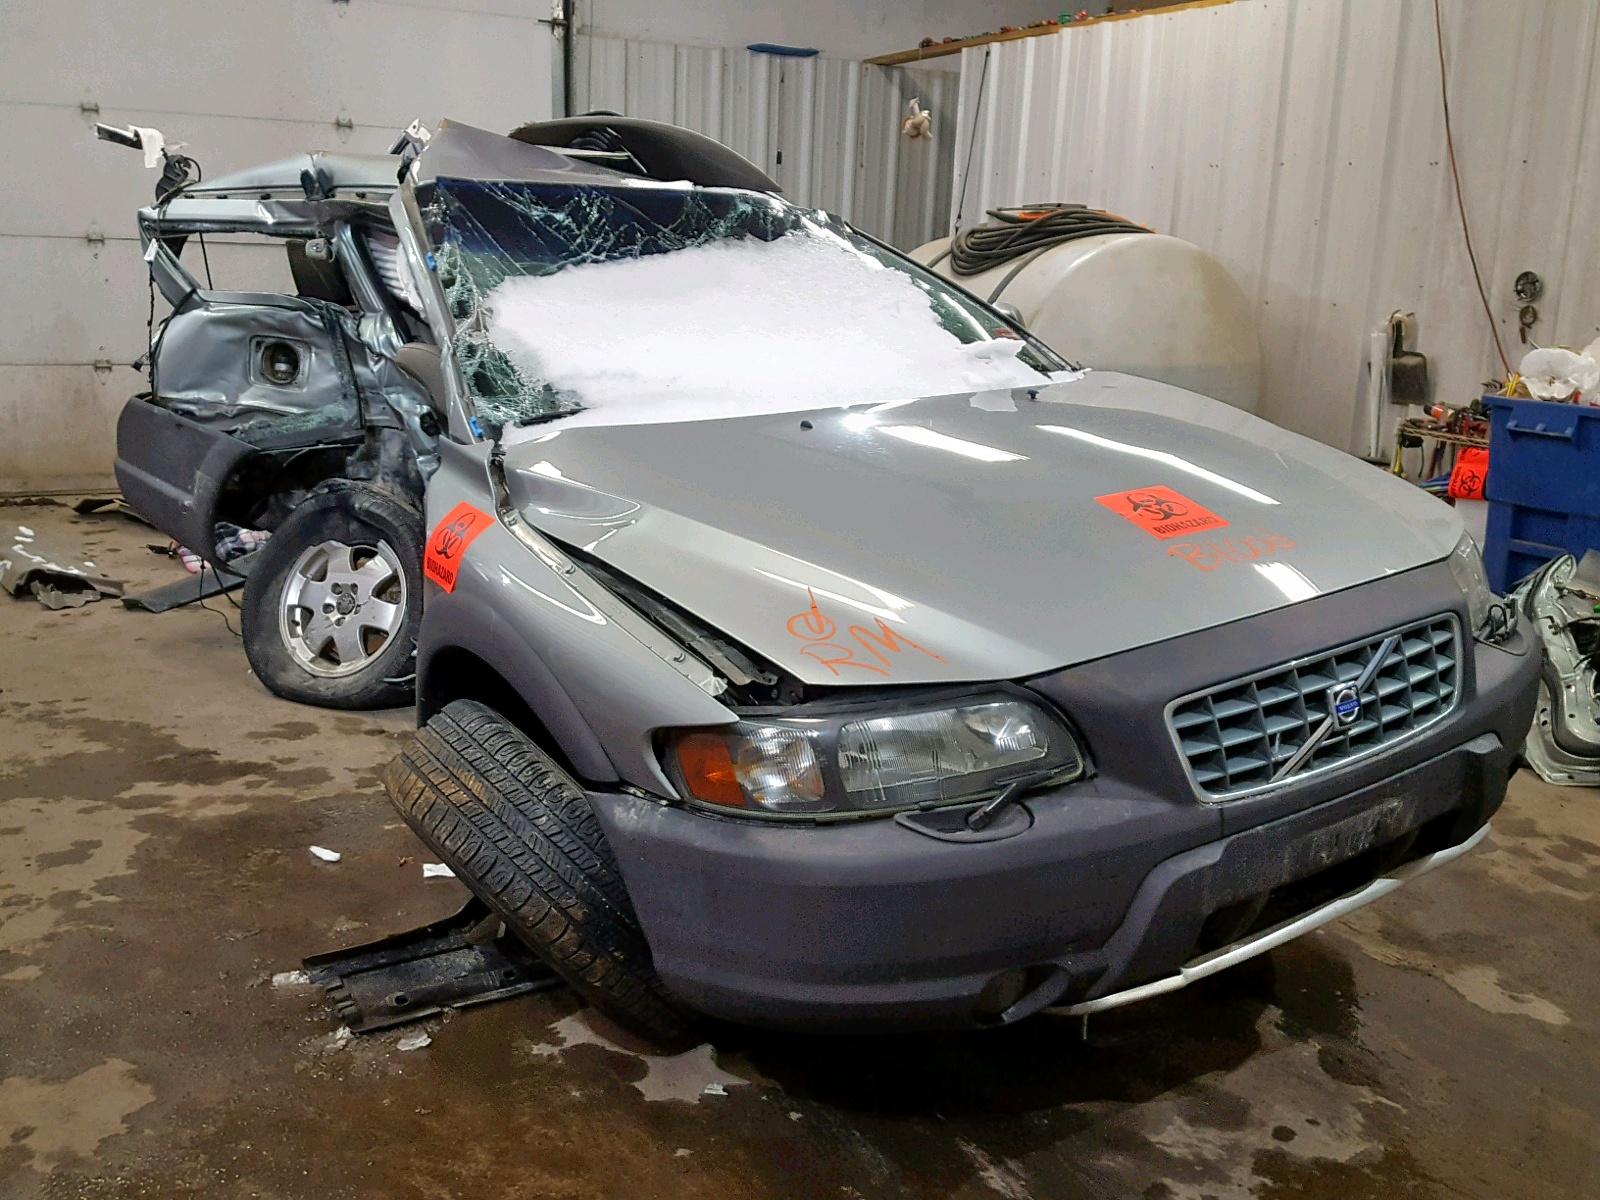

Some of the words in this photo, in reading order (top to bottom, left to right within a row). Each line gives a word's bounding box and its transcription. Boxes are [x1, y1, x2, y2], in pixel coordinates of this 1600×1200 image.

[1153, 516, 1220, 534] BIOHAZARD
[426, 556, 454, 586] BIOHAZARD
[1338, 700, 1359, 711] VOLVO
